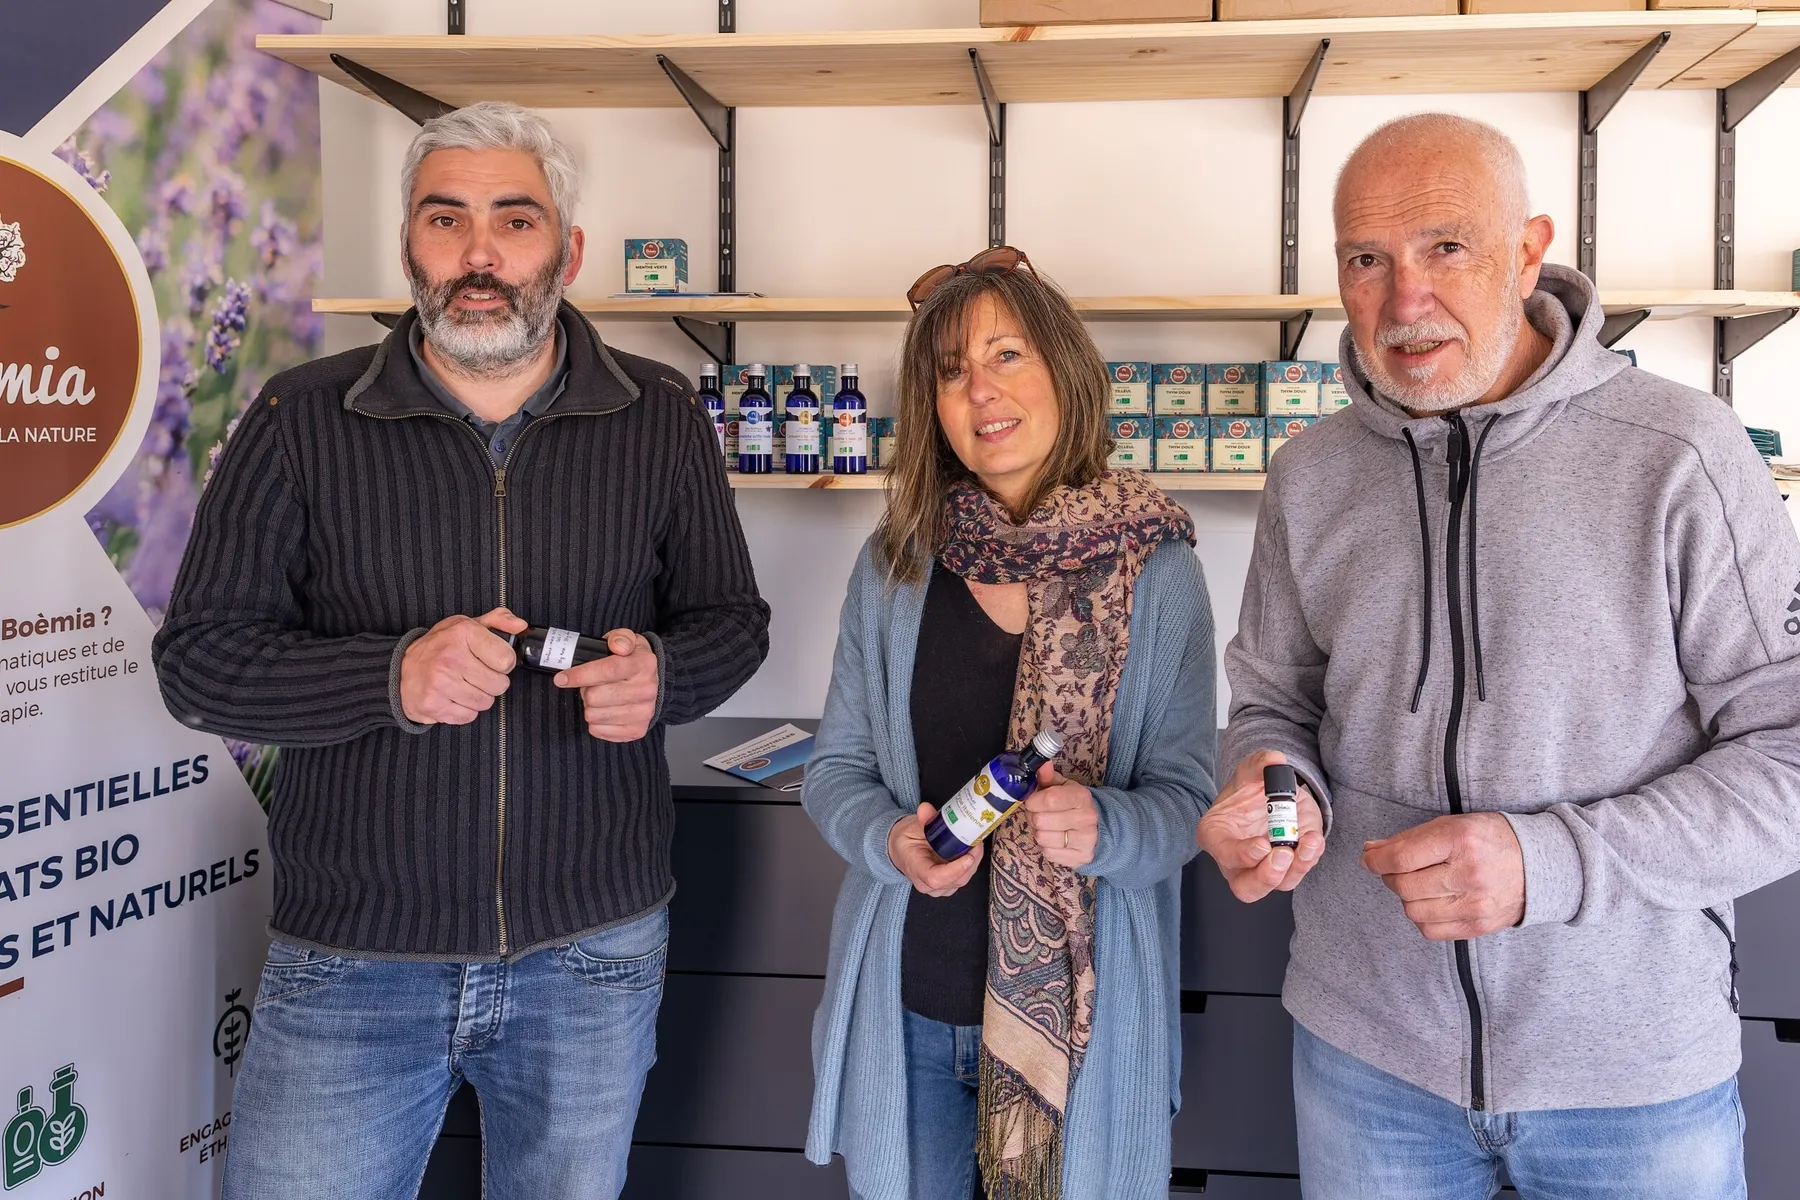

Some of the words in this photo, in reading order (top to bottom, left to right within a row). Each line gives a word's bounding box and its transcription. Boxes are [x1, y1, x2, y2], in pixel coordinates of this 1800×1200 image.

[0, 427, 20, 443] LA
[24, 427, 97, 443] NATURE
[1, 607, 95, 641] Boèmia
[101, 605, 112, 626] ?
[81, 641, 98, 657] et
[102, 636, 125, 654] de
[6, 676, 48, 696] vous
[53, 665, 118, 687] restitue
[123, 658, 139, 675] le
[0, 702, 43, 725] apie.
[0, 754, 209, 840] SENTIELLES
[0, 855, 64, 902] ATS
[75, 833, 140, 880] BIO
[32, 911, 80, 959] ET
[89, 848, 260, 938] NATURELS
